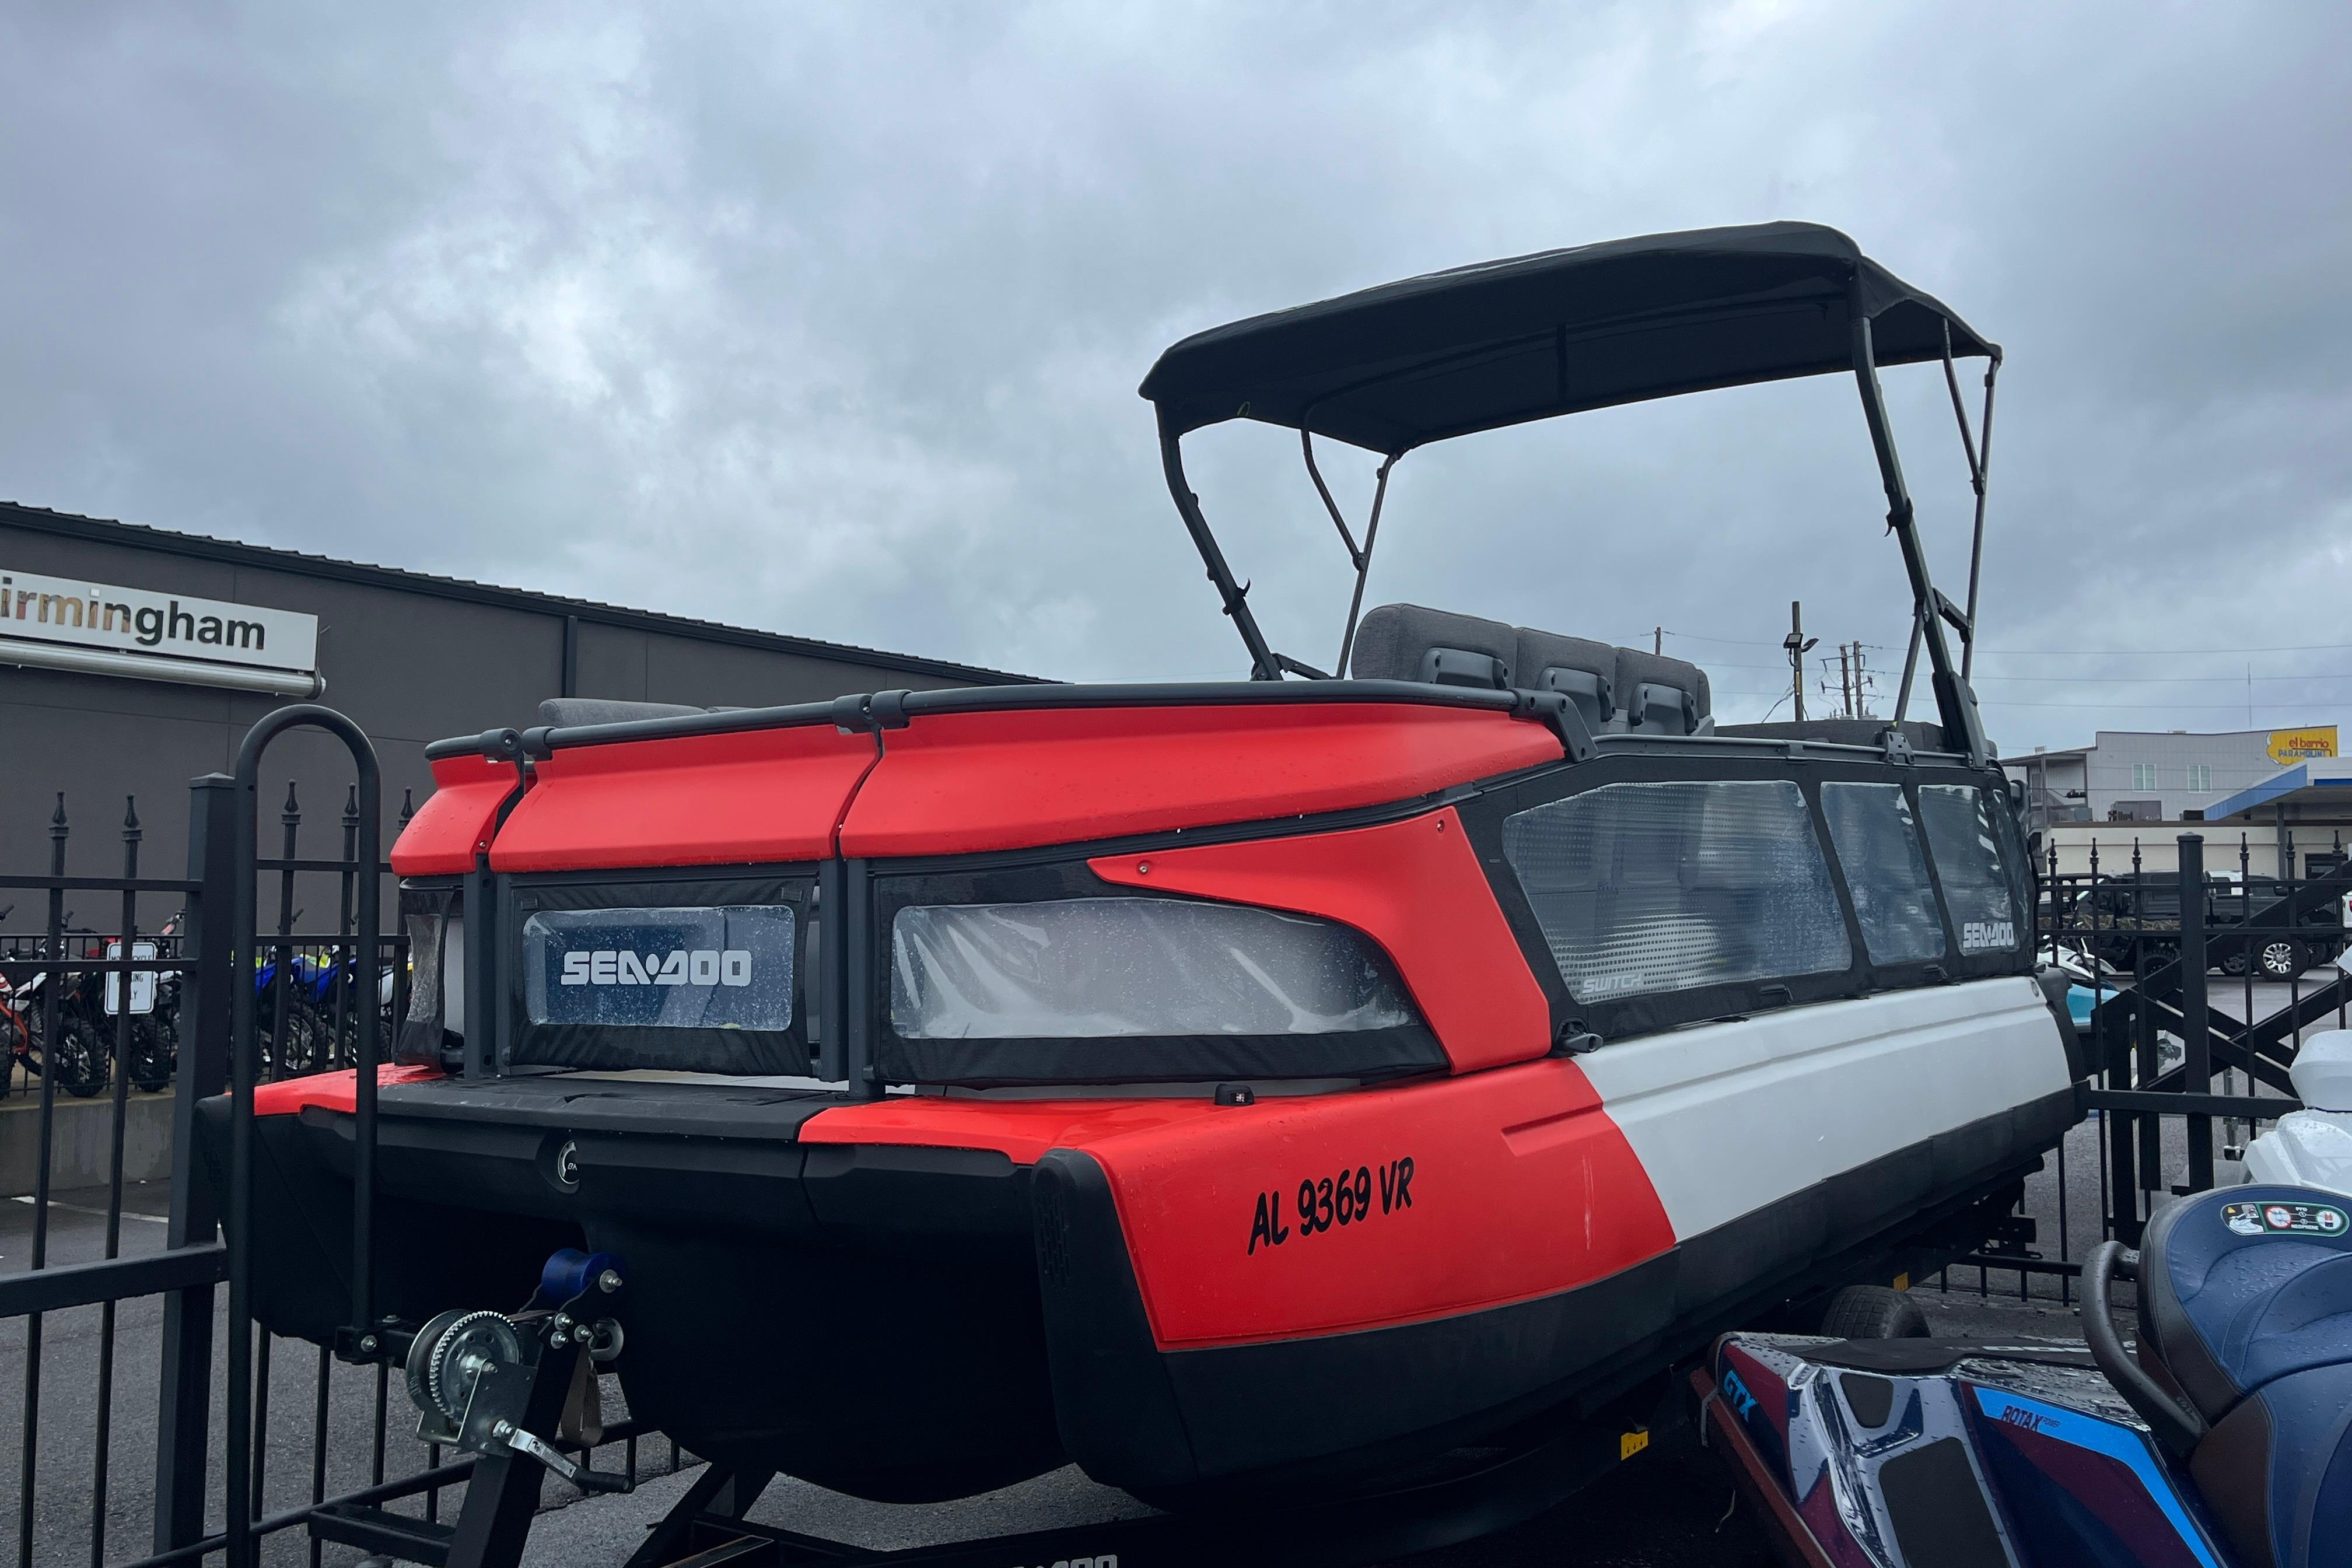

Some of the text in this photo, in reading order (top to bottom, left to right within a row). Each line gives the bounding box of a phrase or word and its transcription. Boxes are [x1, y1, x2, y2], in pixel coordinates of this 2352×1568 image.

[2289, 737, 2329, 748] el barrio
[1582, 973, 1643, 993] SWITCH
[1247, 1157, 1415, 1255] AL 9369 VR
[1724, 1370, 1758, 1423] GTX
[2001, 1405, 2043, 1432] ROTAX
